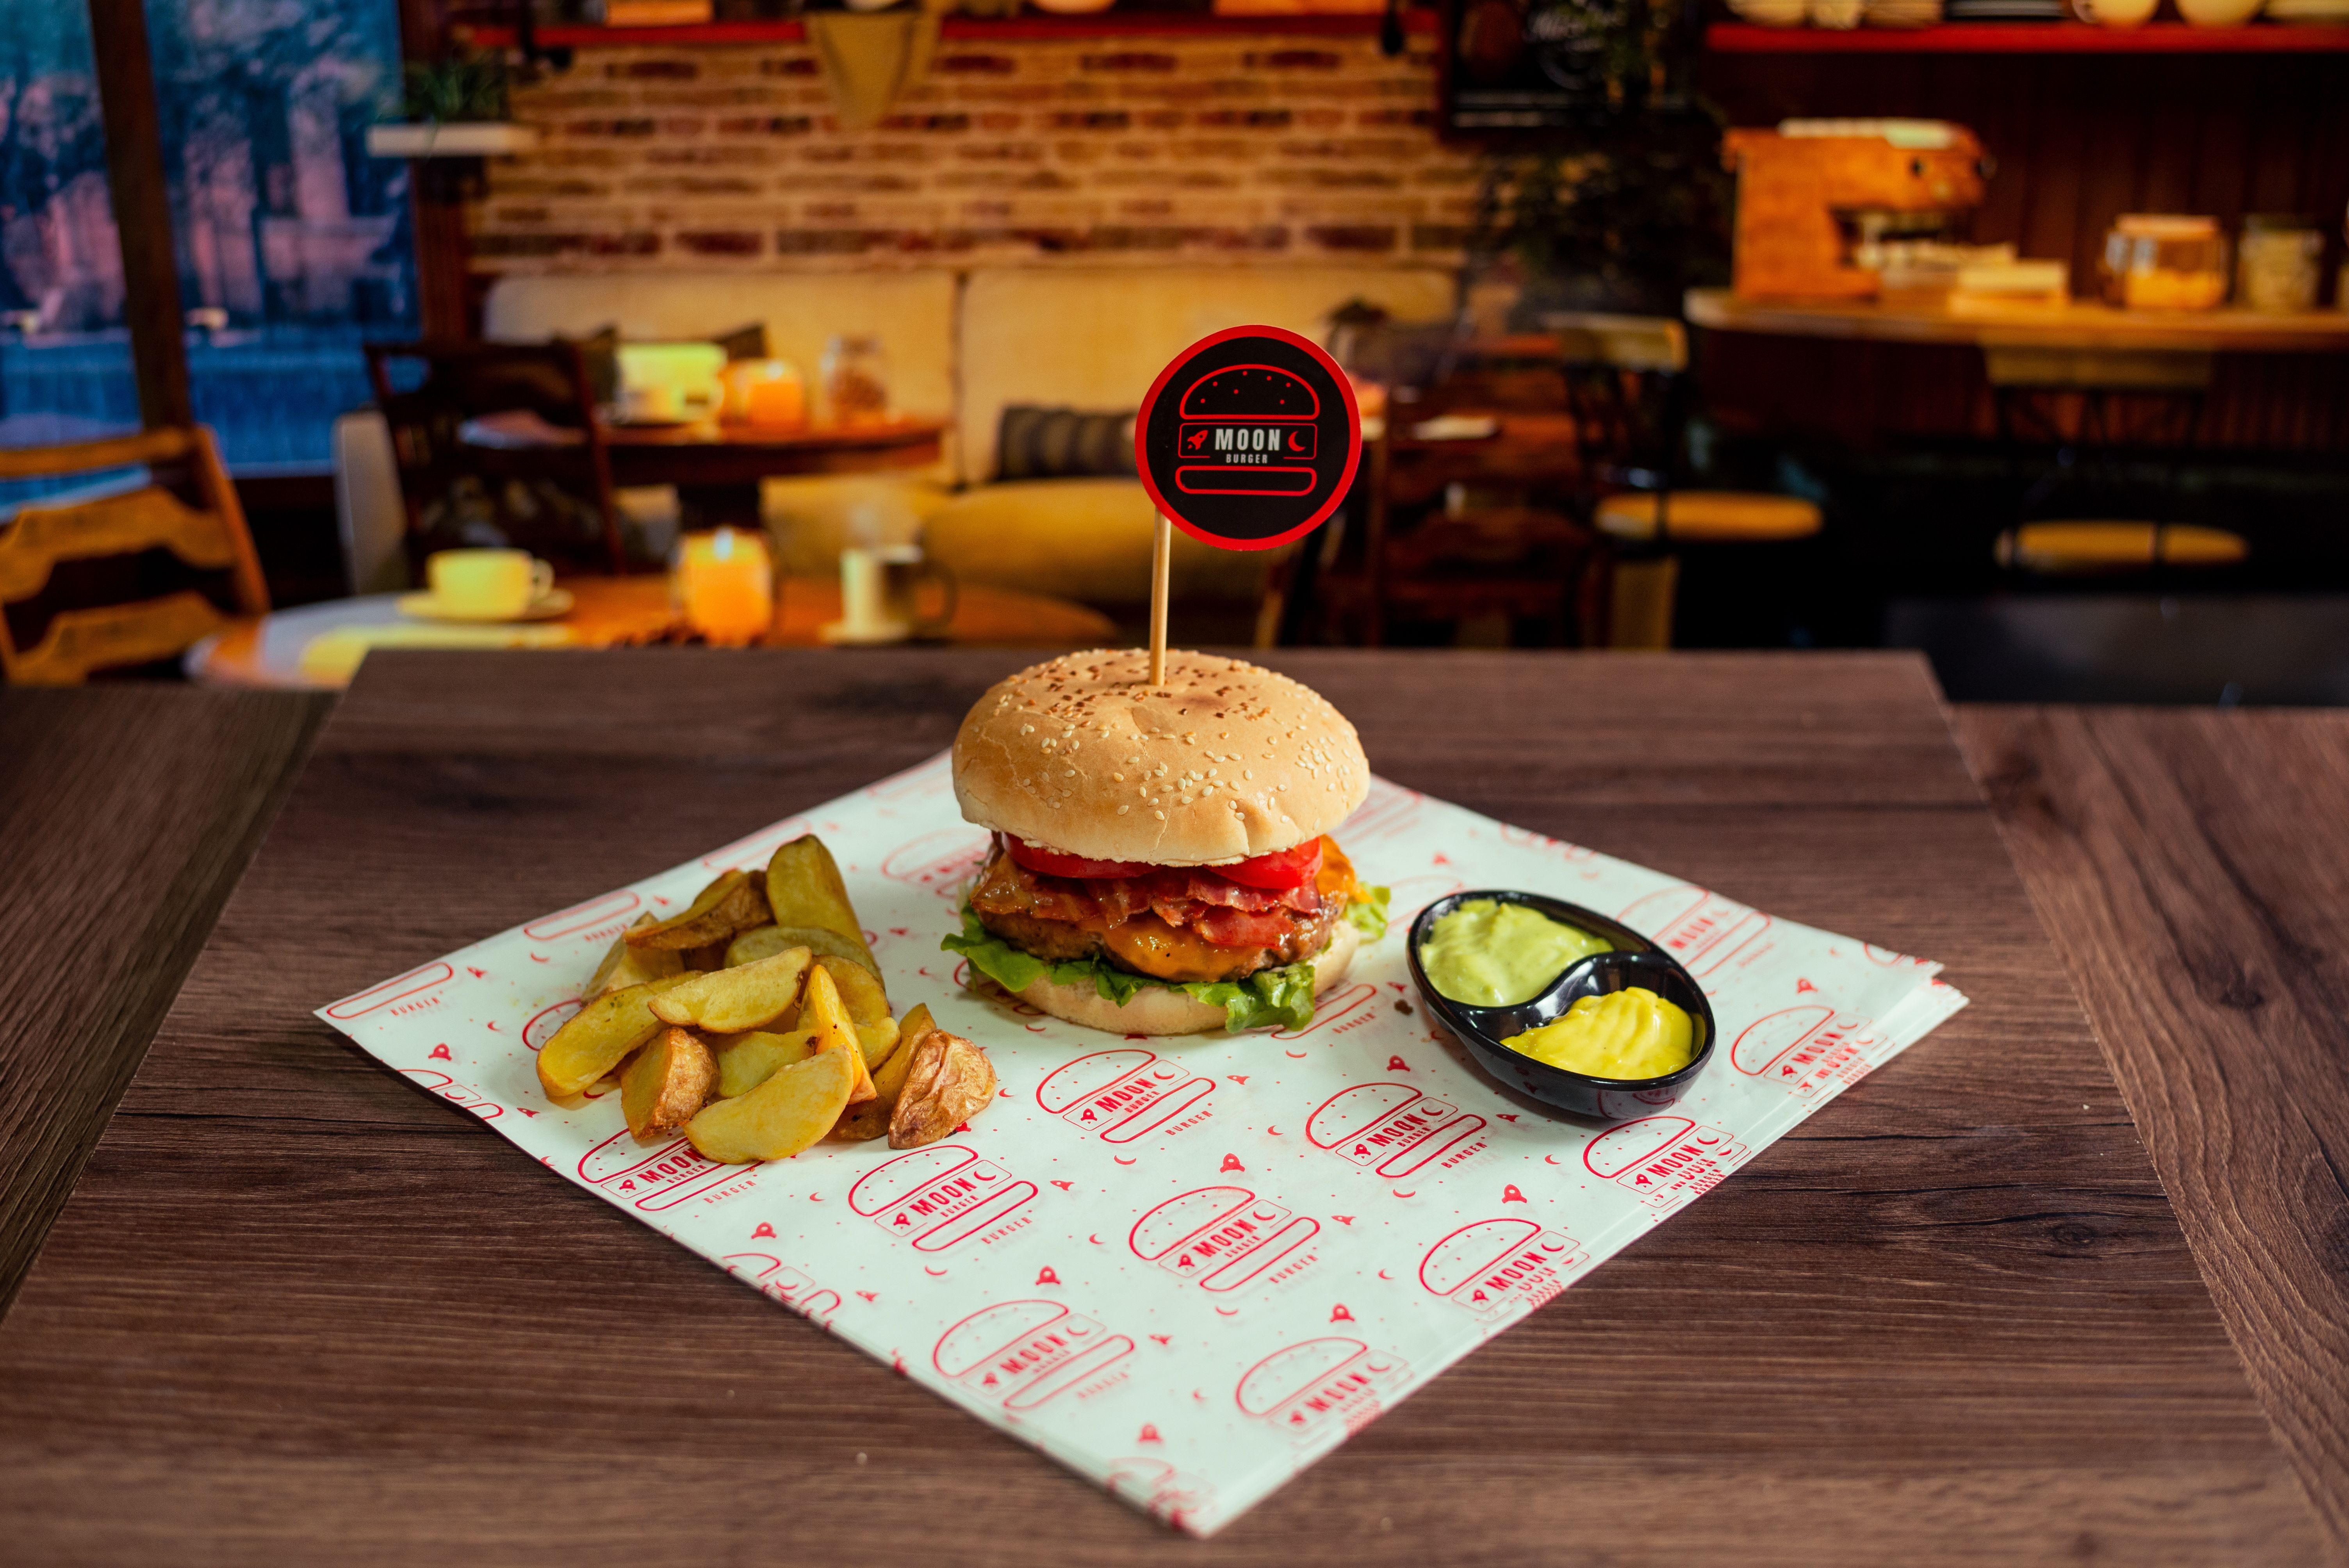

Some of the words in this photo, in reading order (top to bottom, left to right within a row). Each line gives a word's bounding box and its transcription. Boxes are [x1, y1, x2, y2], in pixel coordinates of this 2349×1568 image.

[1215, 429, 1281, 451] MOON
[1226, 454, 1268, 463] BURGER
[1094, 1078, 1158, 1113] MOON
[1124, 1090, 1160, 1113] BURGER
[1165, 1110, 1214, 1135] BURGER
[1367, 1113, 1427, 1147] MOON
[1397, 1127, 1431, 1147] BURGER
[637, 1147, 706, 1183] MOON
[1441, 1142, 1488, 1168] BURGER
[1645, 1144, 1705, 1178] MOON
[666, 1165, 707, 1183] BURGER
[703, 1180, 756, 1203] BURGER
[909, 1178, 977, 1216] MOON
[940, 1195, 979, 1218] BURGER
[980, 1216, 1033, 1245] BURGER
[1192, 1219, 1258, 1258] MOON
[1484, 1251, 1548, 1292] MOON
